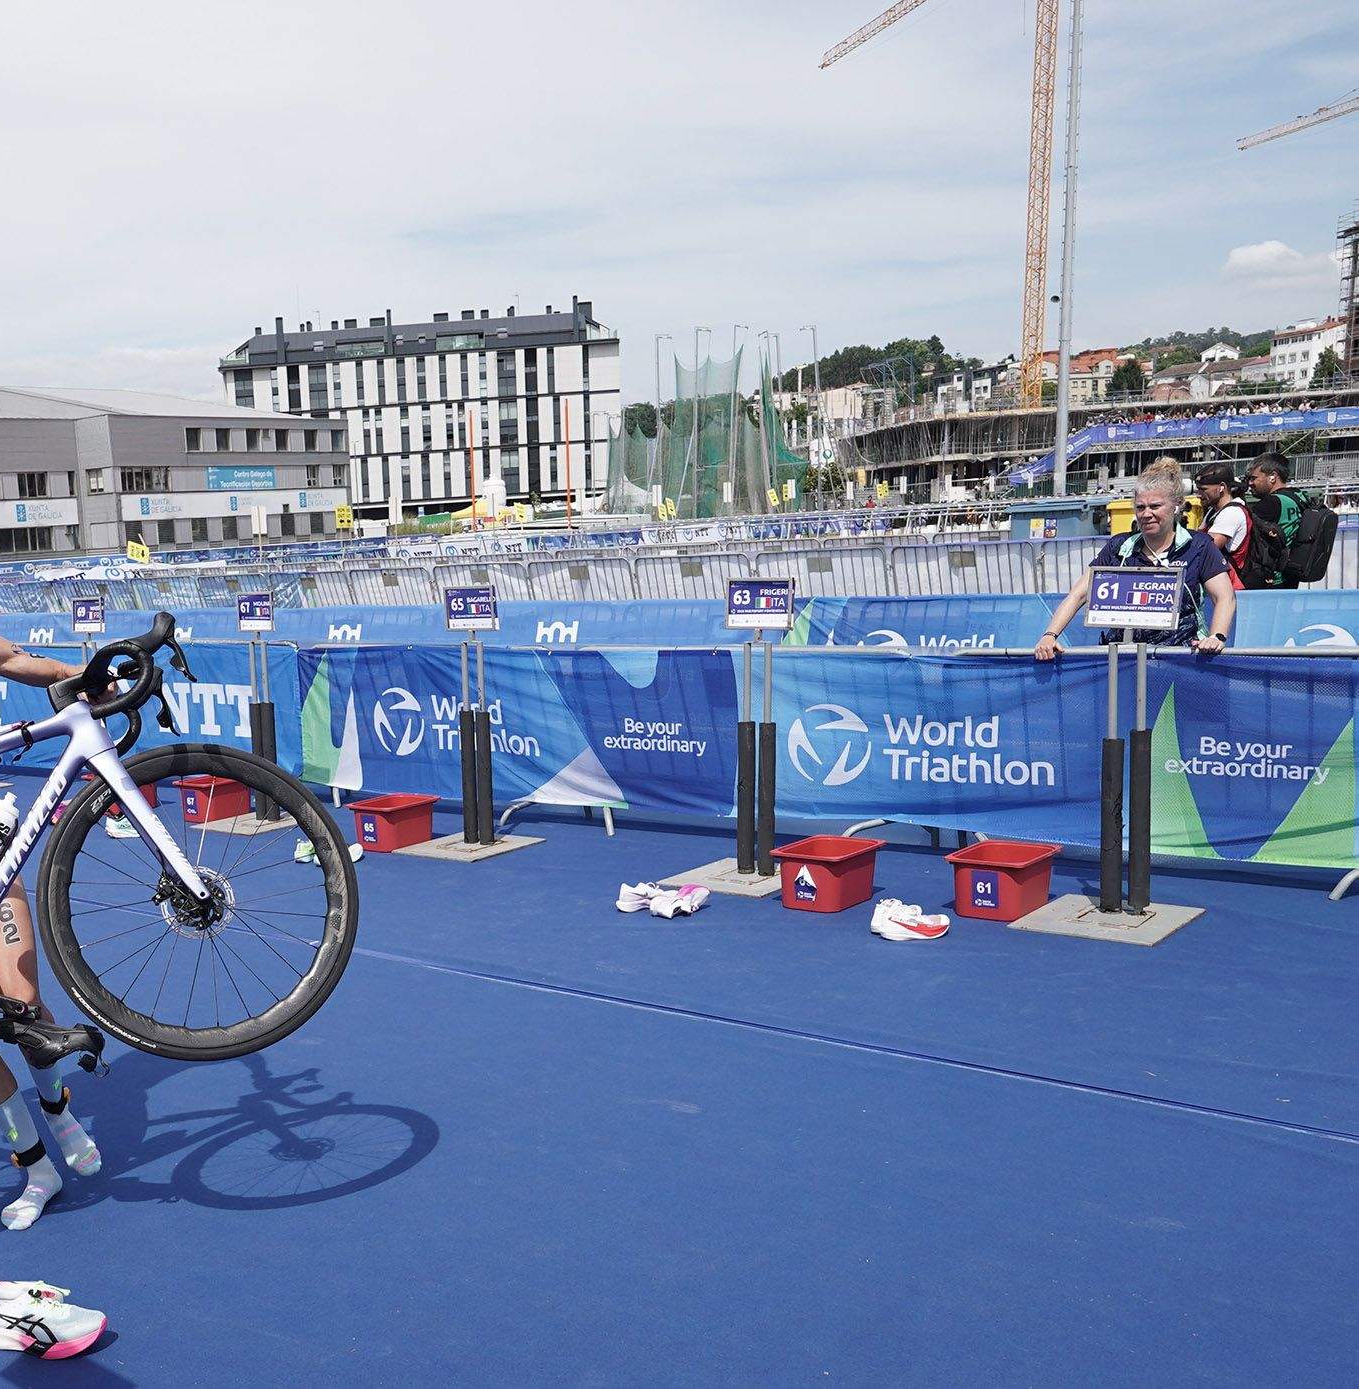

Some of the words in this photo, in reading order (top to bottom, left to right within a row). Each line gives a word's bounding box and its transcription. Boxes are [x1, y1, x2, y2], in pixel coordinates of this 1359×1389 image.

[733, 589, 751, 605] 63
[1097, 582, 1119, 600] 61
[451, 598, 464, 611] 65
[771, 597, 785, 607] ITA
[1148, 593, 1174, 604] FRA
[77, 606, 86, 617] 69
[240, 601, 250, 613] 67
[480, 604, 491, 612] ITA
[158, 682, 252, 738] NTT
[624, 718, 644, 733] Be
[646, 721, 683, 737] your
[883, 714, 999, 748] World
[603, 735, 707, 757] extraordinary
[1200, 737, 1230, 757] Be
[1235, 742, 1292, 762] your
[883, 749, 1055, 786] Triathlon
[1164, 758, 1330, 785] extraordinary
[186, 797, 195, 806] 67
[363, 822, 374, 833] 65
[976, 882, 992, 894] 61
